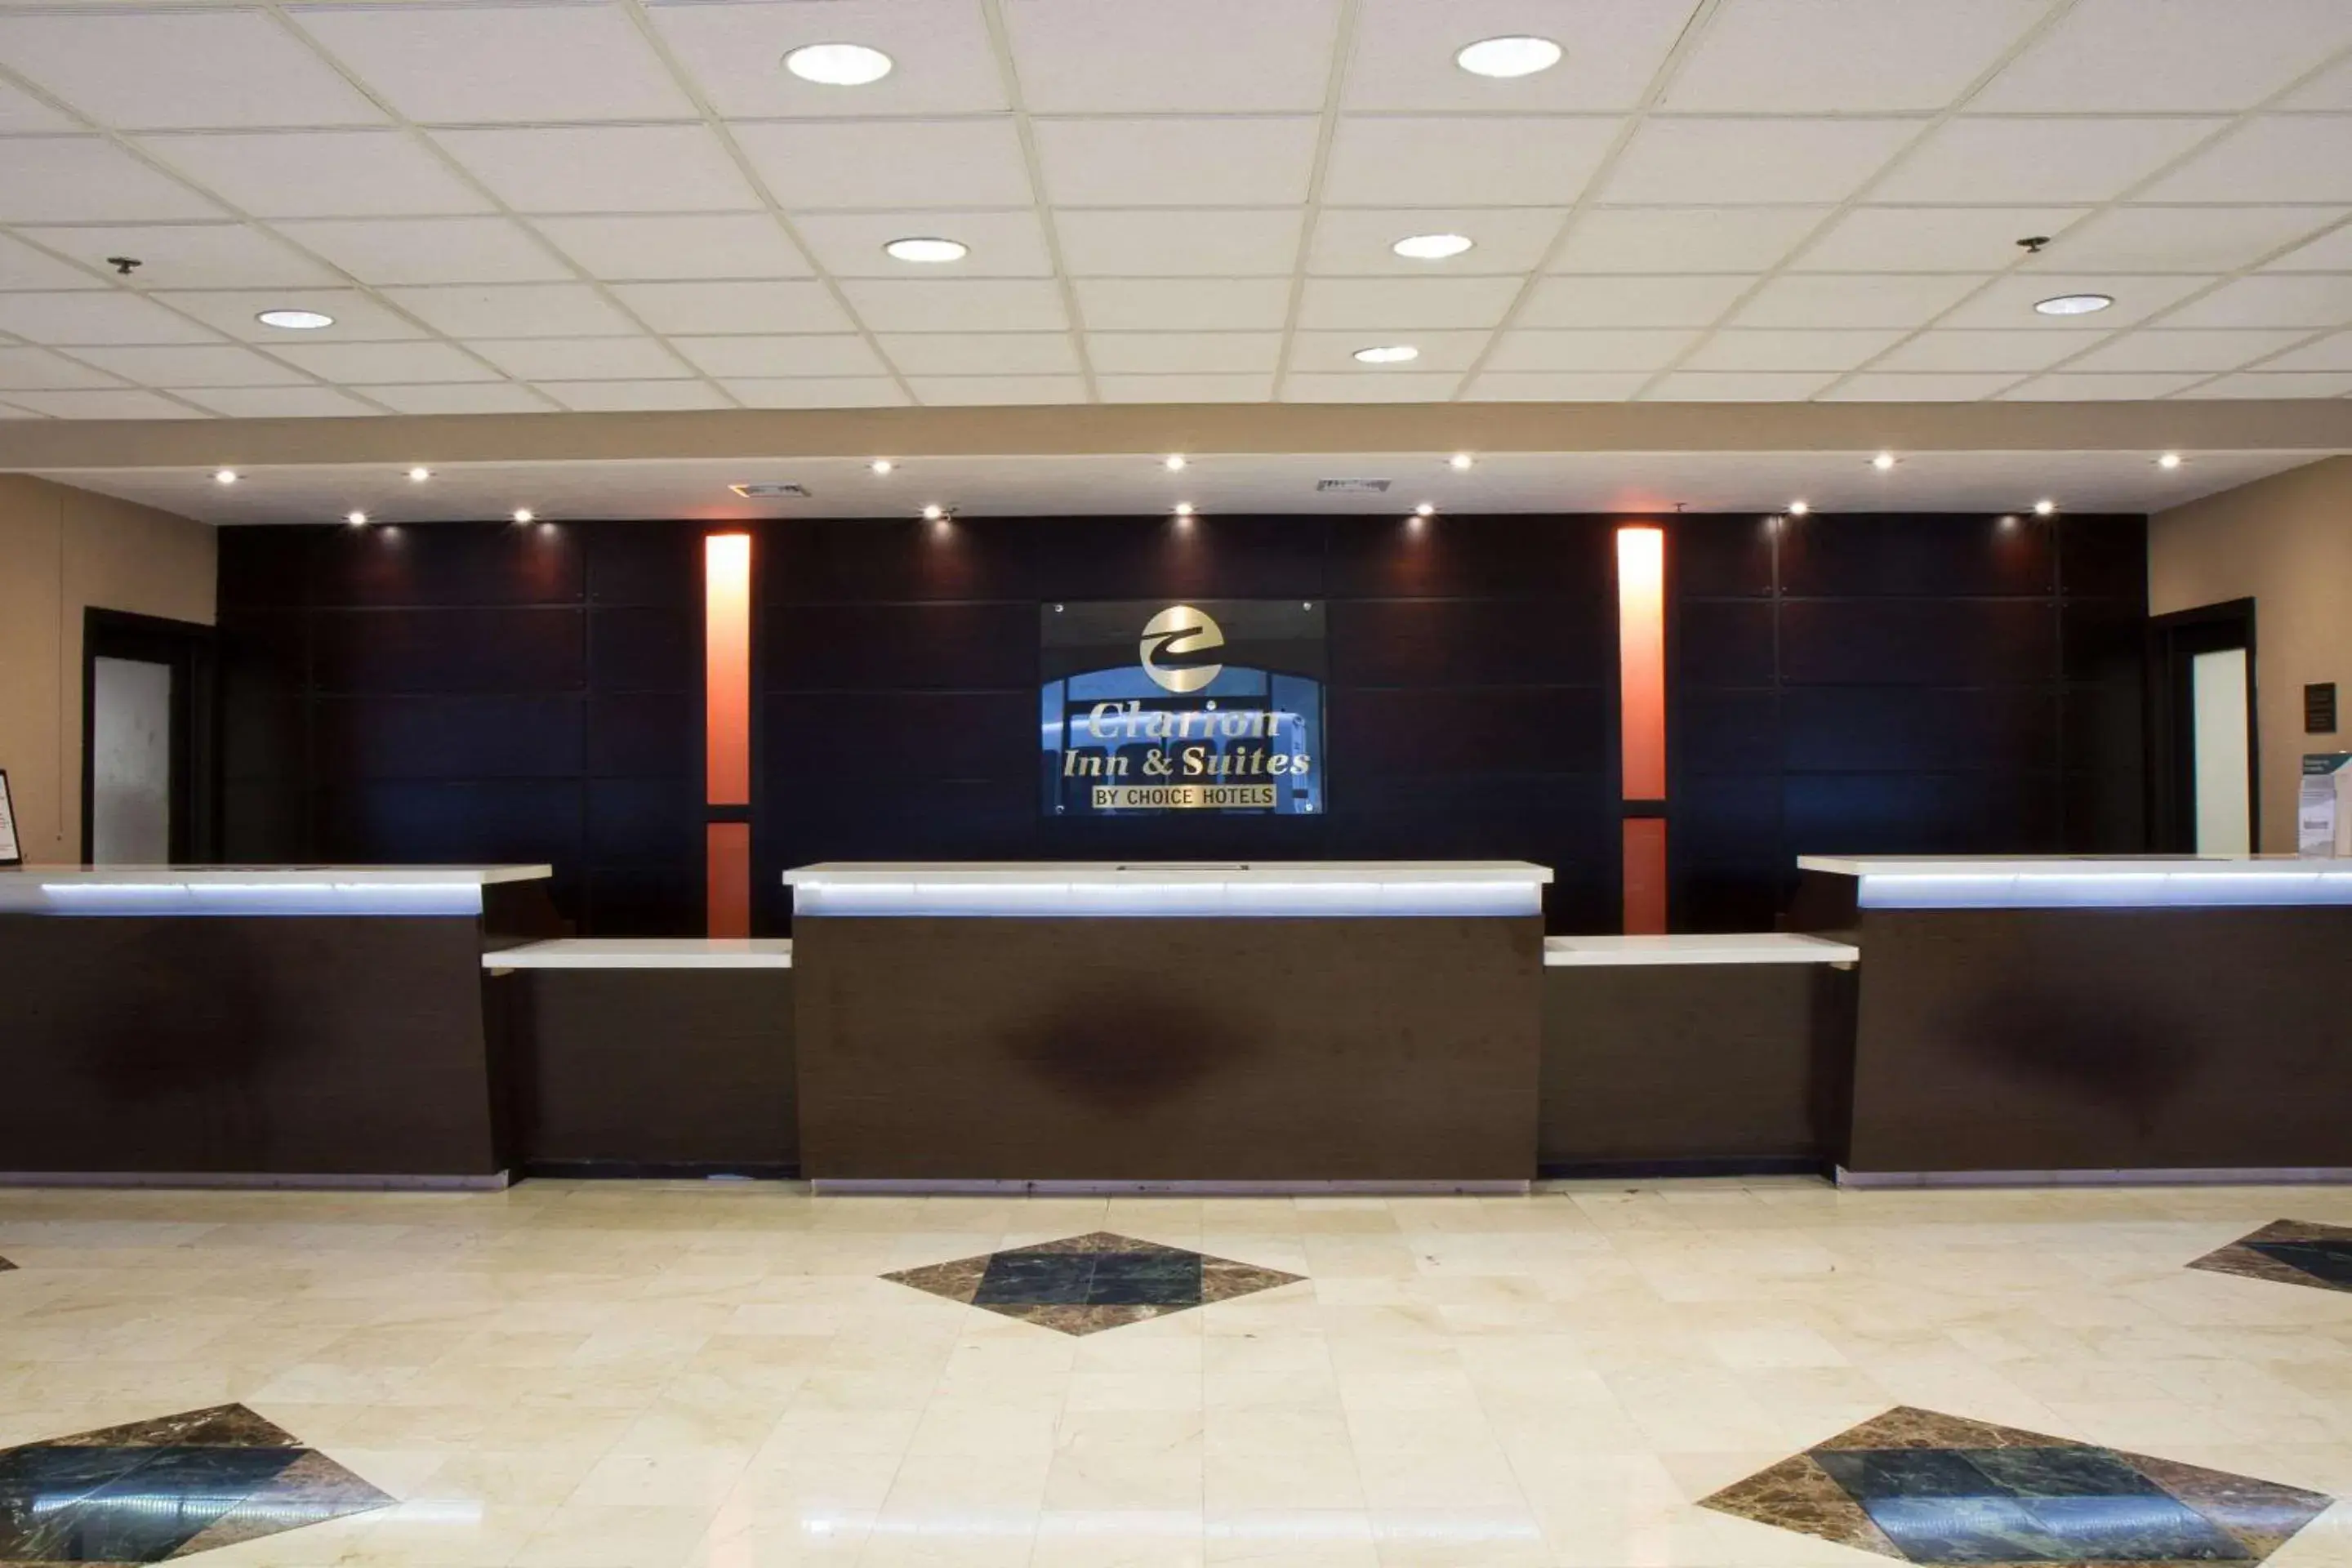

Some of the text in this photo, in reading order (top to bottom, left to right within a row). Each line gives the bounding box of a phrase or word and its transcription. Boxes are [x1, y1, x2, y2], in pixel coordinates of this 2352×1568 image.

[1088, 701, 1280, 737] Clarion
[1064, 746, 1311, 777] Inn & Suites
[1096, 788, 1273, 805] BY CHOICE HOTELS
